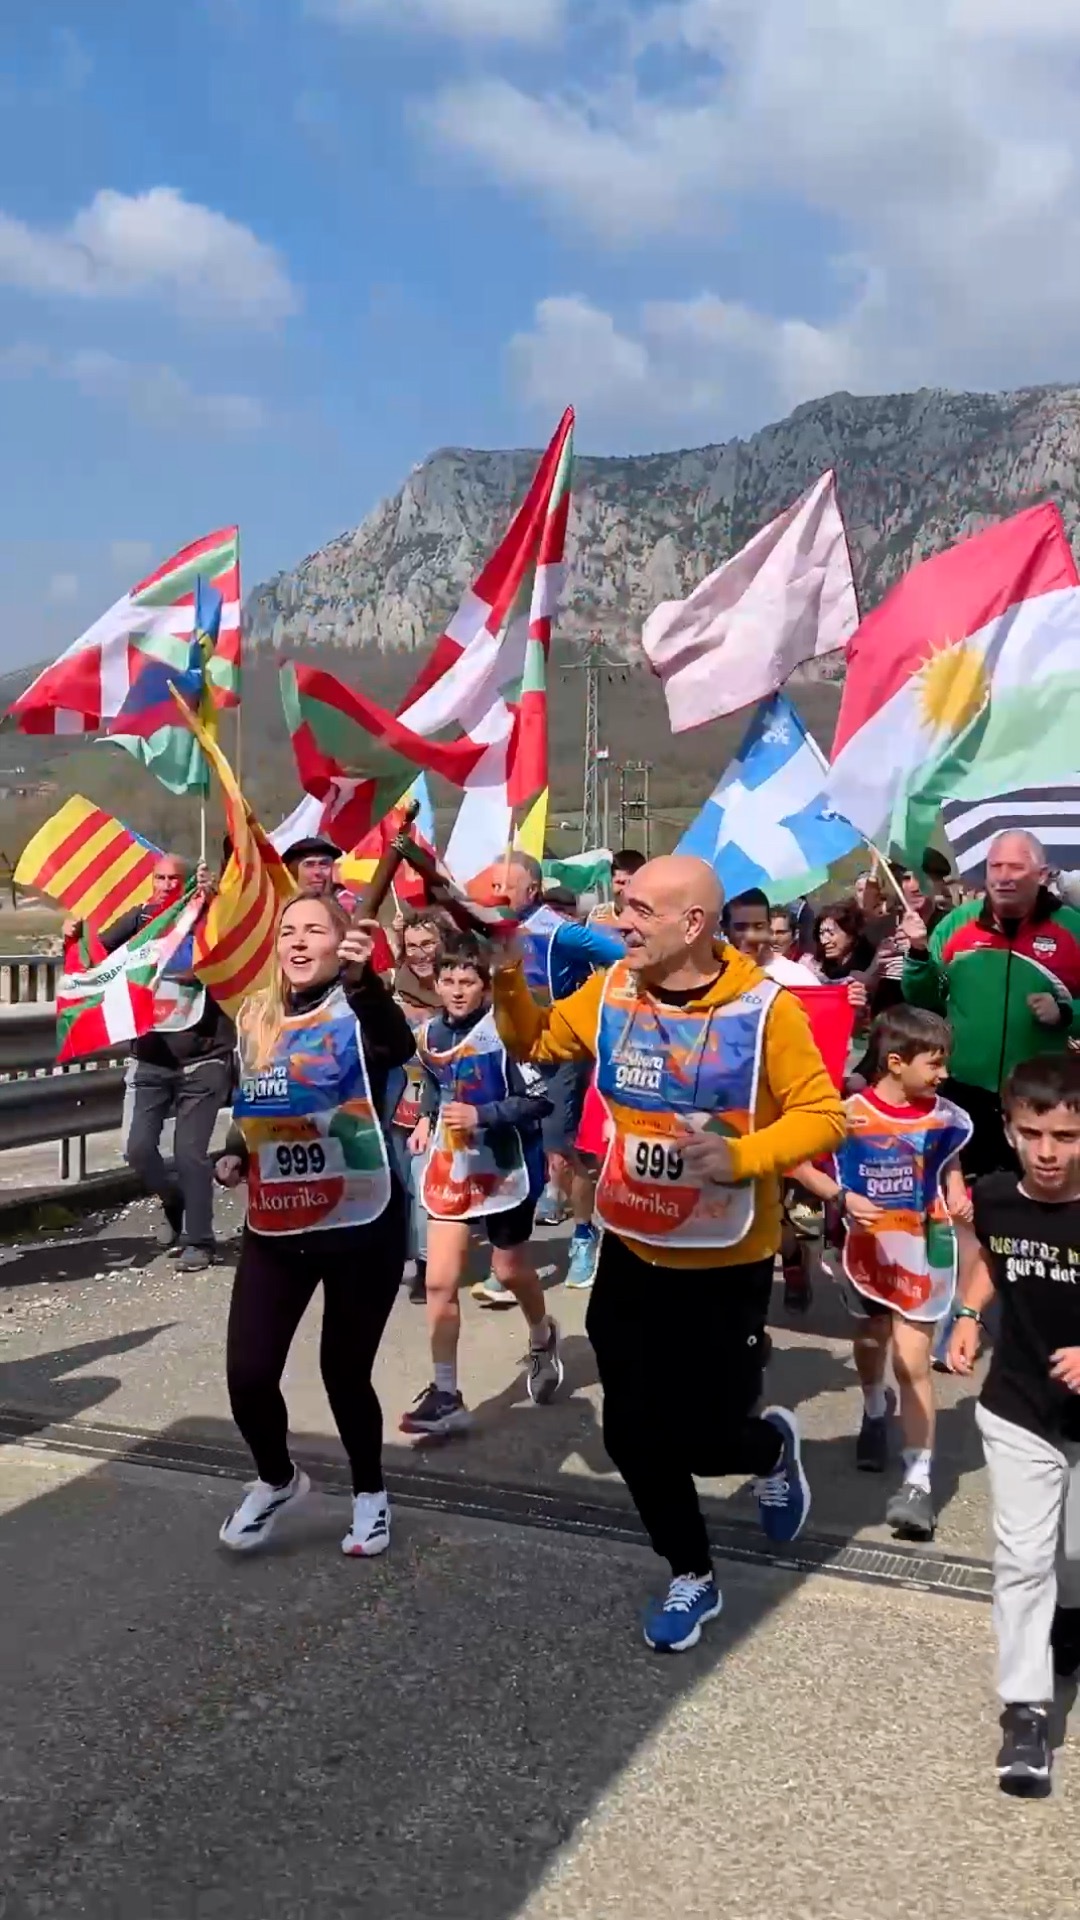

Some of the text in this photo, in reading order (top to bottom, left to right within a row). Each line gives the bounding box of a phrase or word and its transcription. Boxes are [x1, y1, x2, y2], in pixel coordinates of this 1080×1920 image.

[615, 1066, 661, 1089] gara
[242, 1079, 288, 1102] gara
[276, 1142, 326, 1176] 999
[635, 1141, 684, 1181] 999
[866, 1176, 914, 1198] gara
[1006, 1257, 1046, 1282] gura
